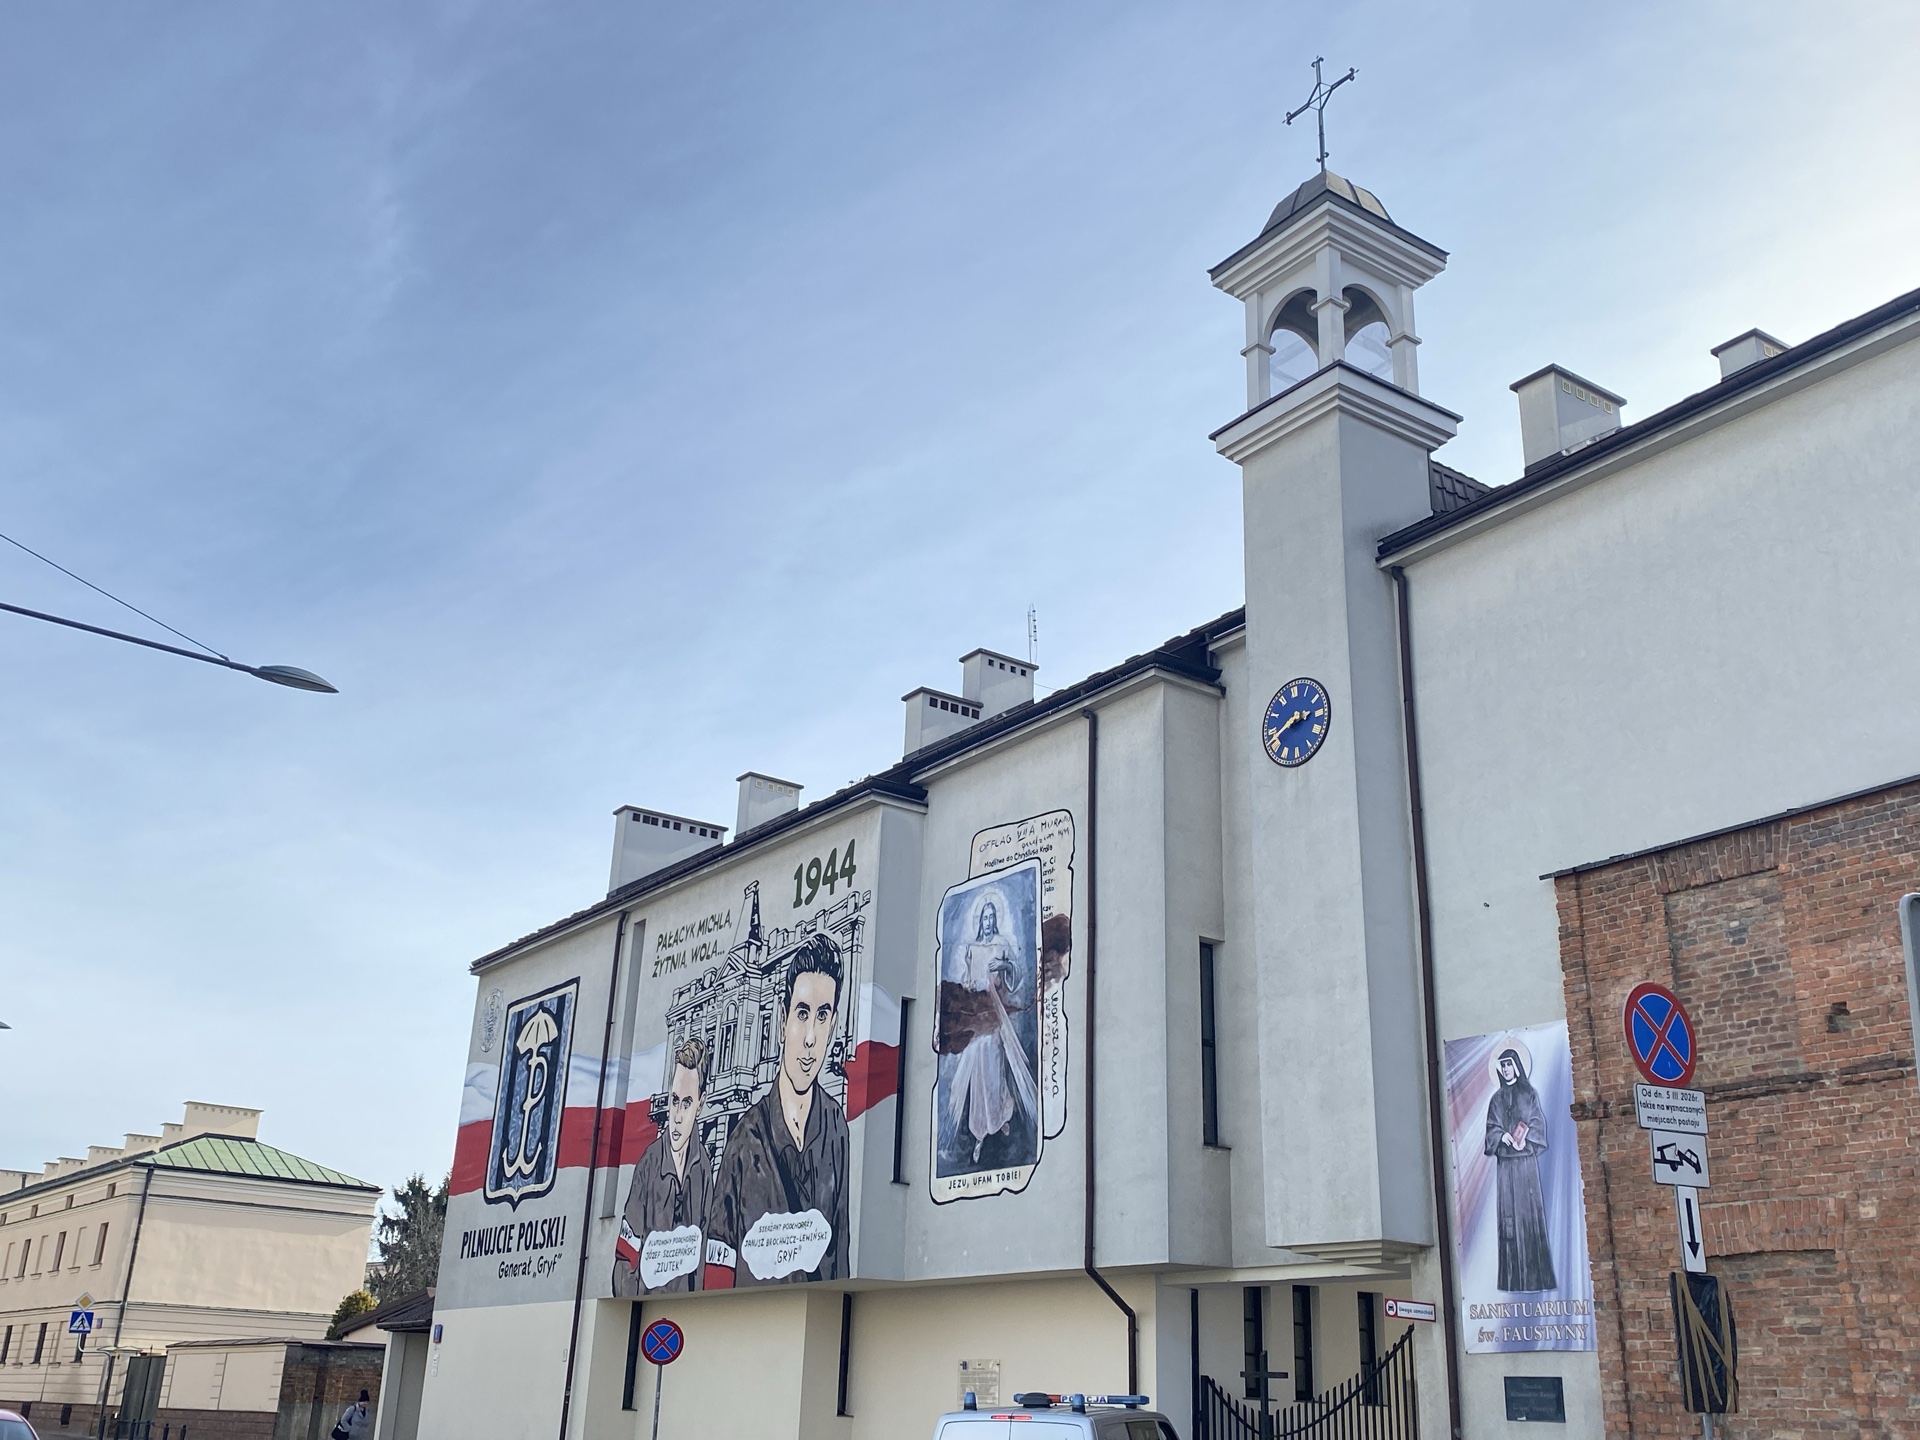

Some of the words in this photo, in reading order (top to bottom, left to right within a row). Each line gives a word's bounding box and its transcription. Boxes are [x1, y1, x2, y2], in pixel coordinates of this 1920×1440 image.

[979, 834, 1012, 853] OFFLAG
[793, 838, 857, 909] 1944
[656, 922, 697, 953] PAŁACYK
[696, 909, 732, 938] MICHLA,
[652, 950, 687, 978] ŻYTNIA,
[1641, 1088, 1651, 1097] Od
[1654, 1090, 1664, 1099] dn.
[1666, 1091, 1671, 1100] 5
[1640, 1101, 1655, 1110] także
[1665, 1104, 1705, 1116] wyznaczonych
[1647, 1114, 1677, 1125] miejscach
[1678, 1117, 1700, 1128] postoju
[949, 1179, 969, 1190] JEZU,
[973, 1175, 992, 1186] UFAM
[460, 1223, 515, 1259] PILNUJCIE
[516, 1215, 567, 1252] POLSKI!
[744, 1238, 764, 1248] JANUSZ
[498, 1256, 532, 1279] Generał
[1469, 1299, 1590, 1320] SANKTUARIUM
[1478, 1326, 1499, 1343] św.
[1502, 1323, 1589, 1343] FAUSTYNY
